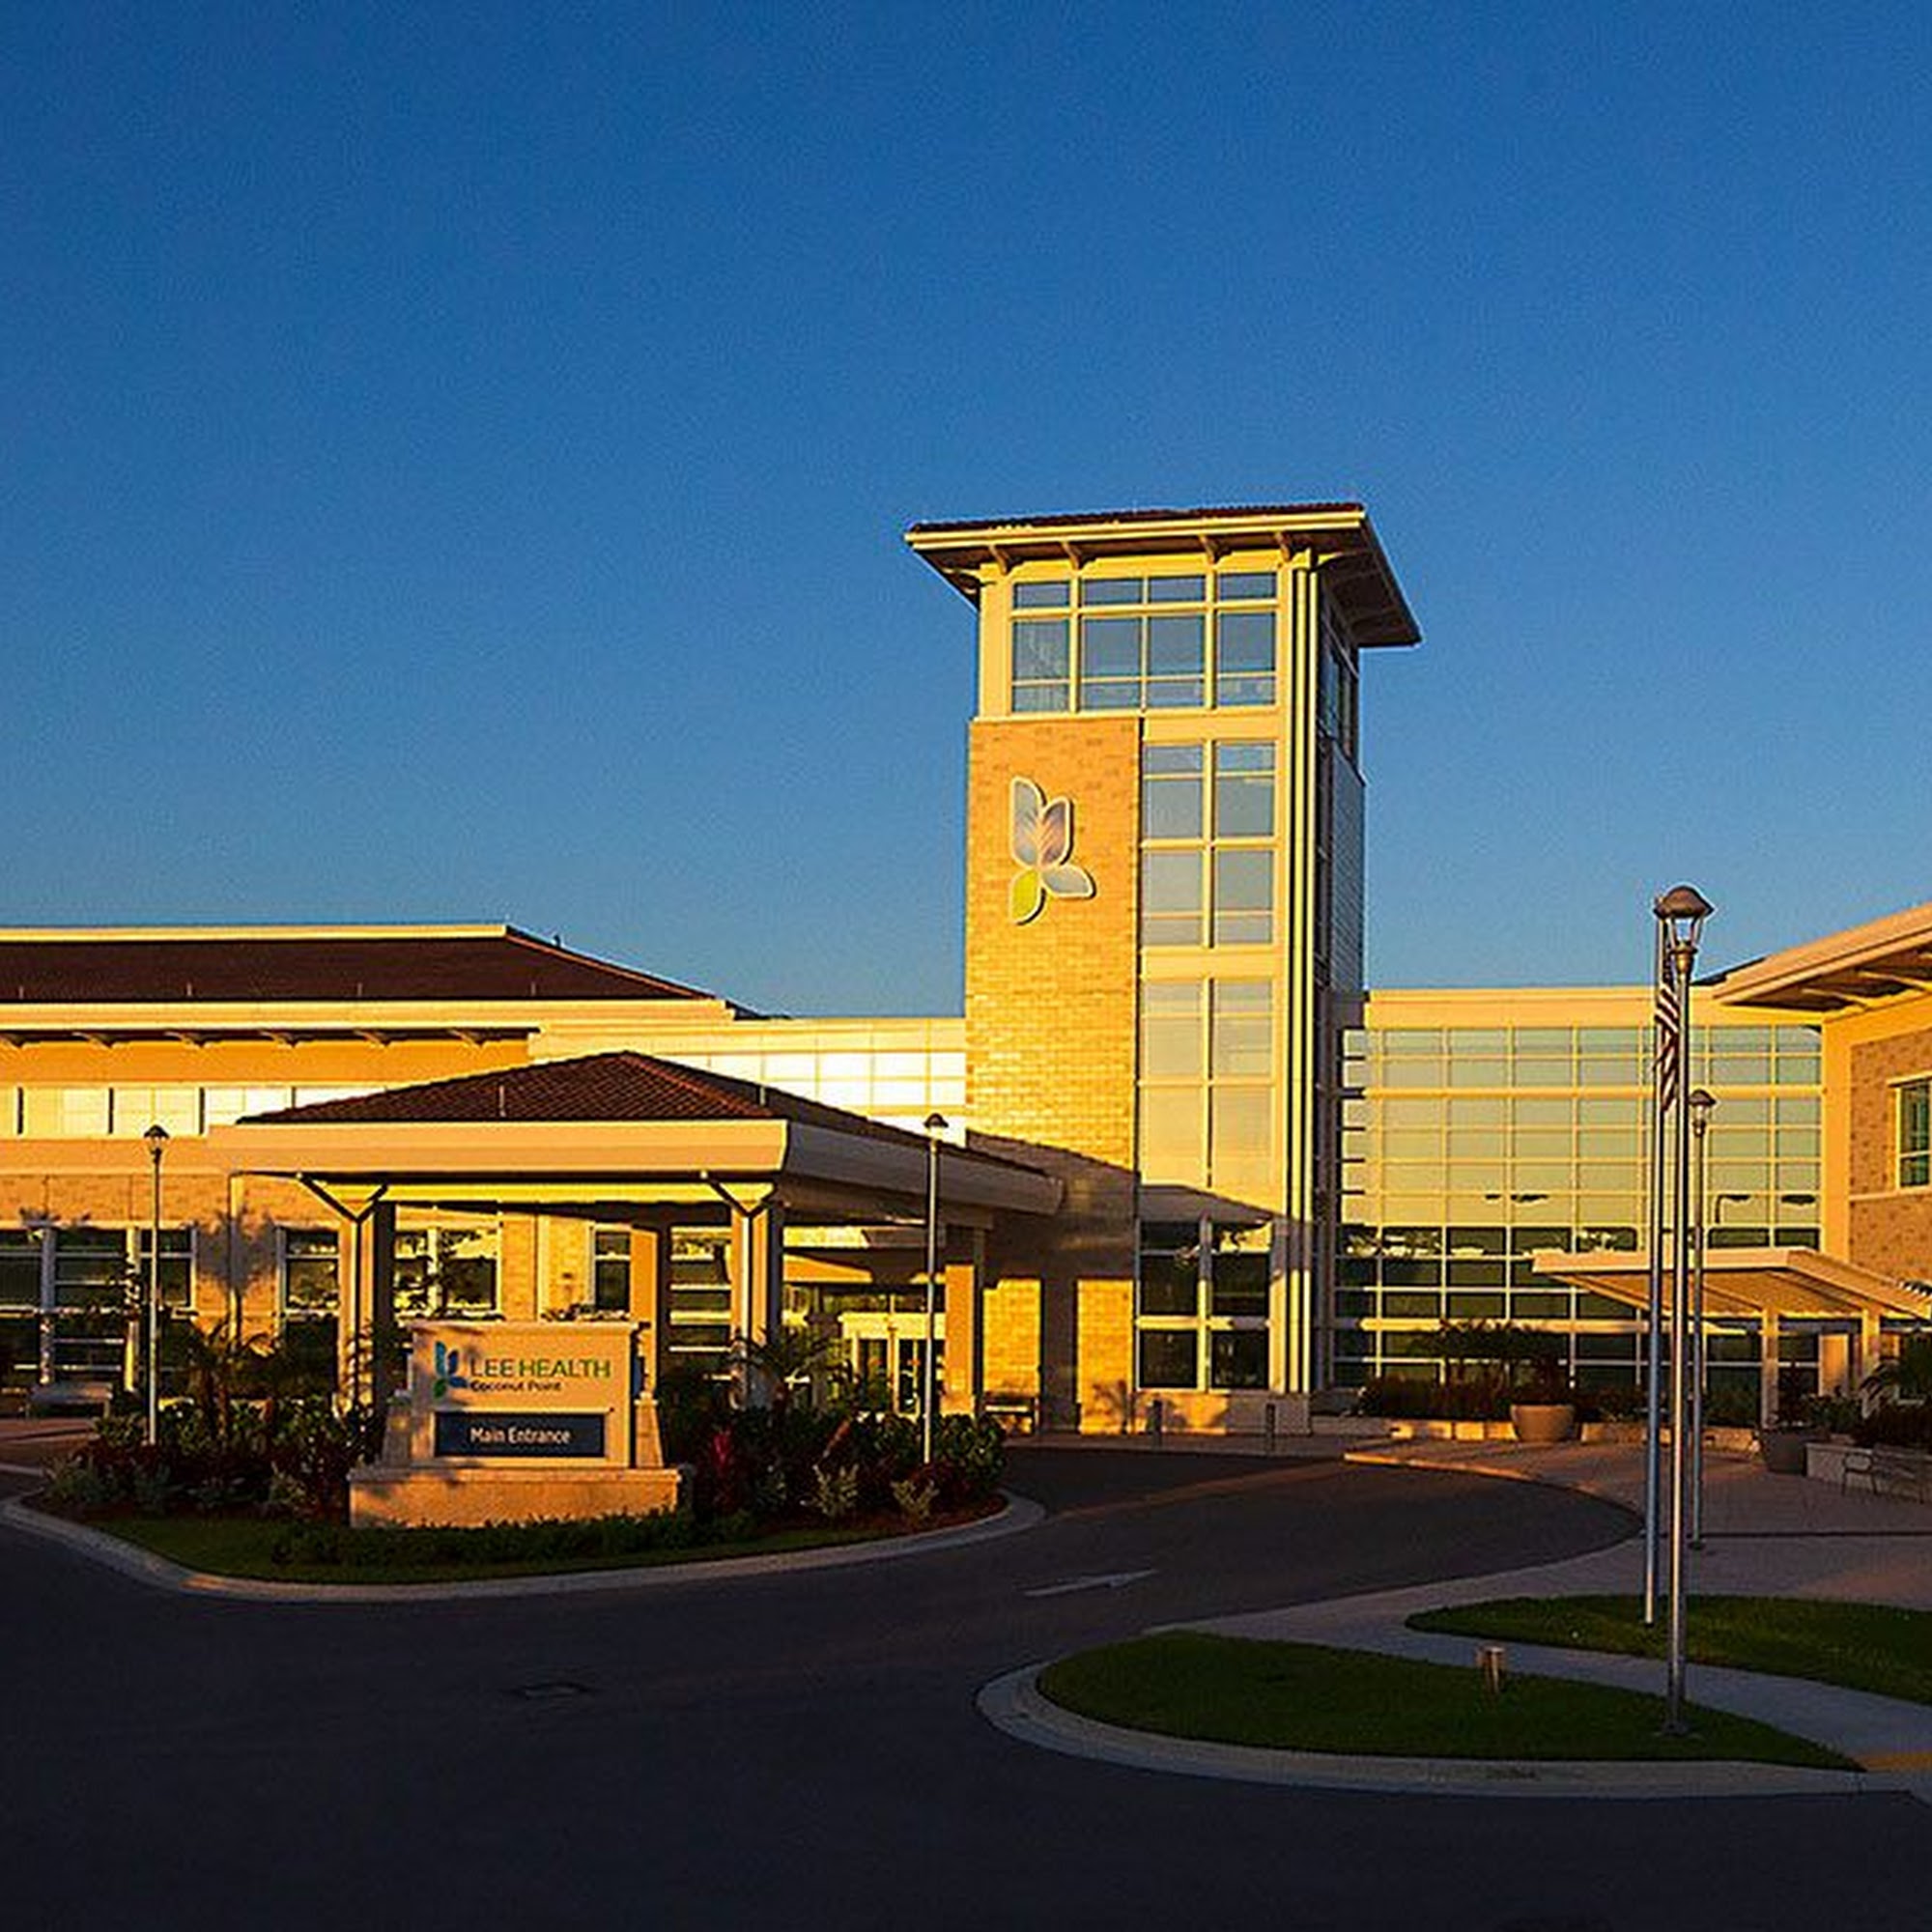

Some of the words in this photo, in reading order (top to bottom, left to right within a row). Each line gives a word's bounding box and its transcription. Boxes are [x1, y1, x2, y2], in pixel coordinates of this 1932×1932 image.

[470, 1358, 514, 1378] LEE
[519, 1358, 611, 1378] HEALTH
[470, 1380, 525, 1392] Coconut
[528, 1380, 562, 1392] Point
[470, 1428, 504, 1443] Main
[508, 1428, 571, 1444] Entrance
